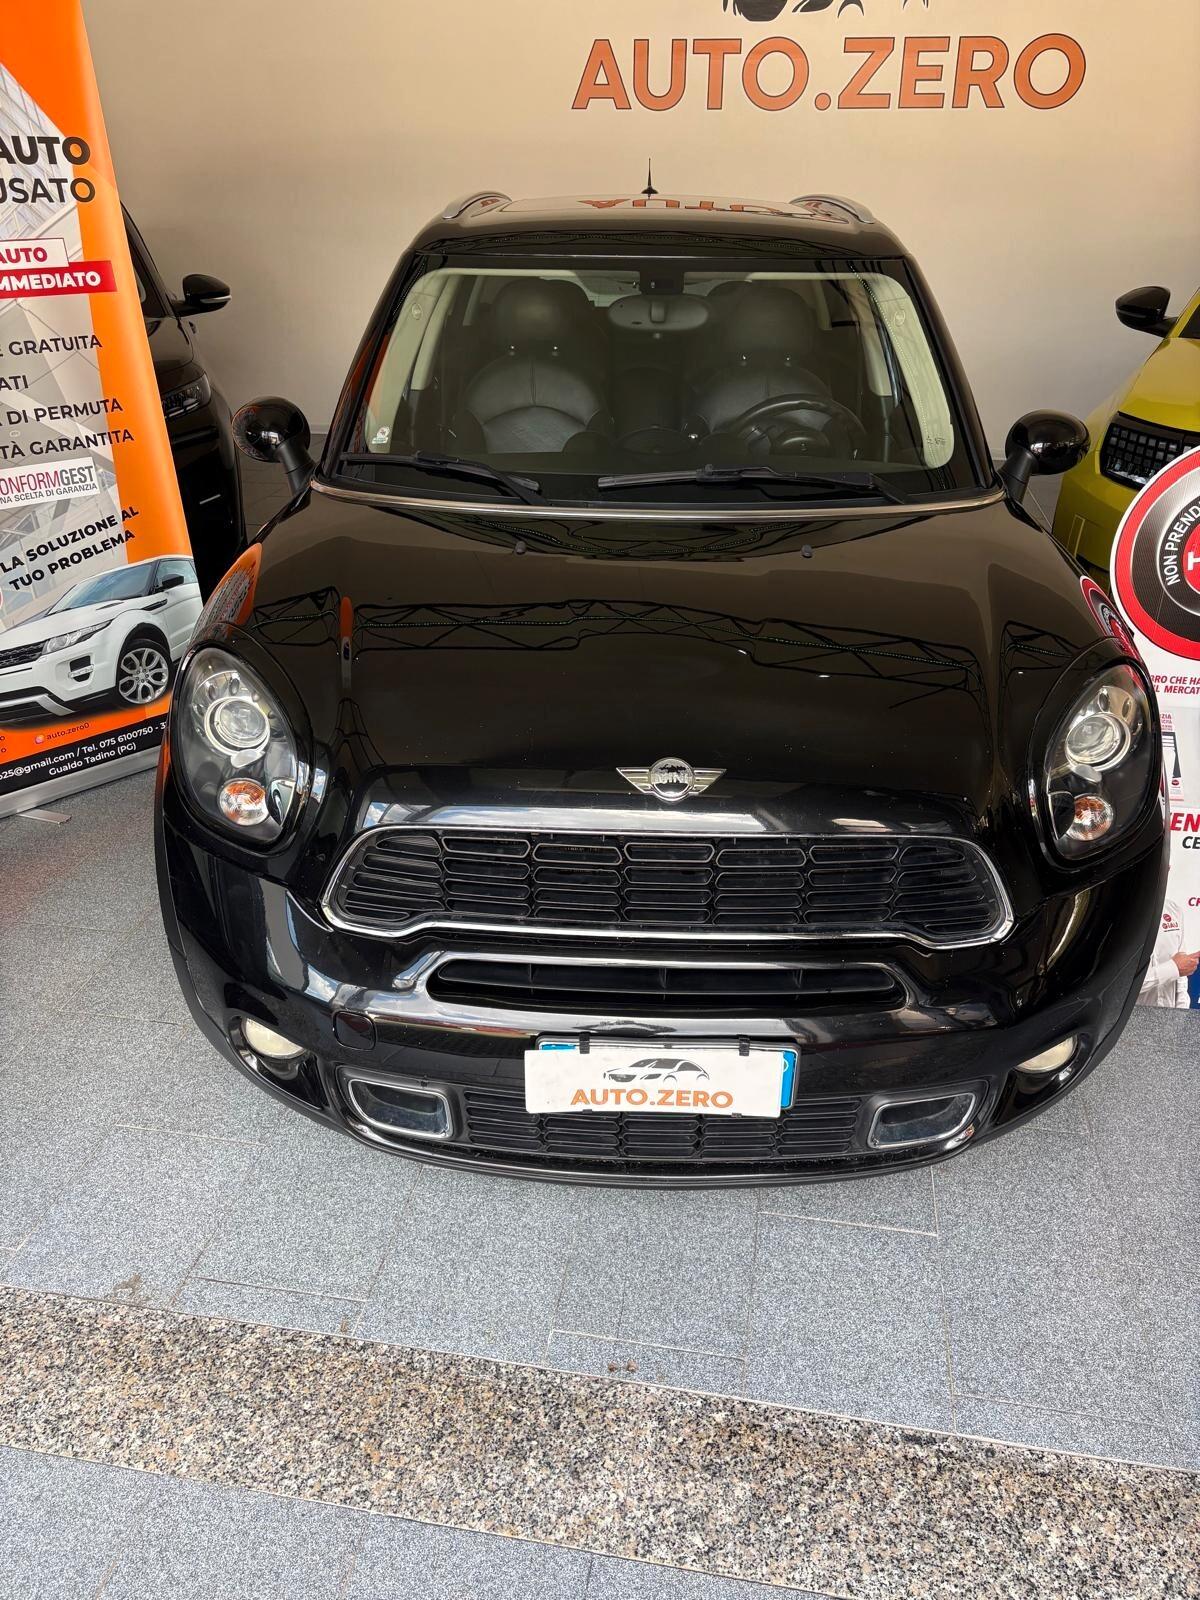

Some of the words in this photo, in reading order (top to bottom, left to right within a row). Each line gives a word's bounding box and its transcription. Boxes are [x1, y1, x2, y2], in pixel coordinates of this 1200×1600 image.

[570, 33, 1087, 111] AUTO.ZERO
[8, 334, 103, 356] GRATUITA
[6, 409, 29, 426] DI
[33, 397, 124, 422] PERMUTA
[29, 428, 135, 456] GARANTITA
[14, 490, 44, 502] SCELTA
[46, 489, 55, 497] DI
[56, 482, 98, 496] GARANZIA
[0, 555, 25, 573] LA
[26, 514, 119, 562] SOLUZIONE
[121, 505, 140, 522] AL
[1164, 501, 1200, 551] PREND
[9, 569, 45, 591] TUO
[47, 529, 136, 574] PROBLEMA
[1163, 555, 1181, 586] NON
[1169, 675, 1188, 685] CHE
[76, 747, 80, 757] /
[81, 743, 98, 754] Tel.
[99, 737, 117, 749] 075
[117, 726, 154, 743] 6100750
[49, 760, 83, 776] Gualdo
[83, 749, 116, 765] Tadino
[117, 742, 137, 756] (PG)
[1169, 812, 1200, 833] EN
[570, 1088, 734, 1109] AUTO.ZERO
